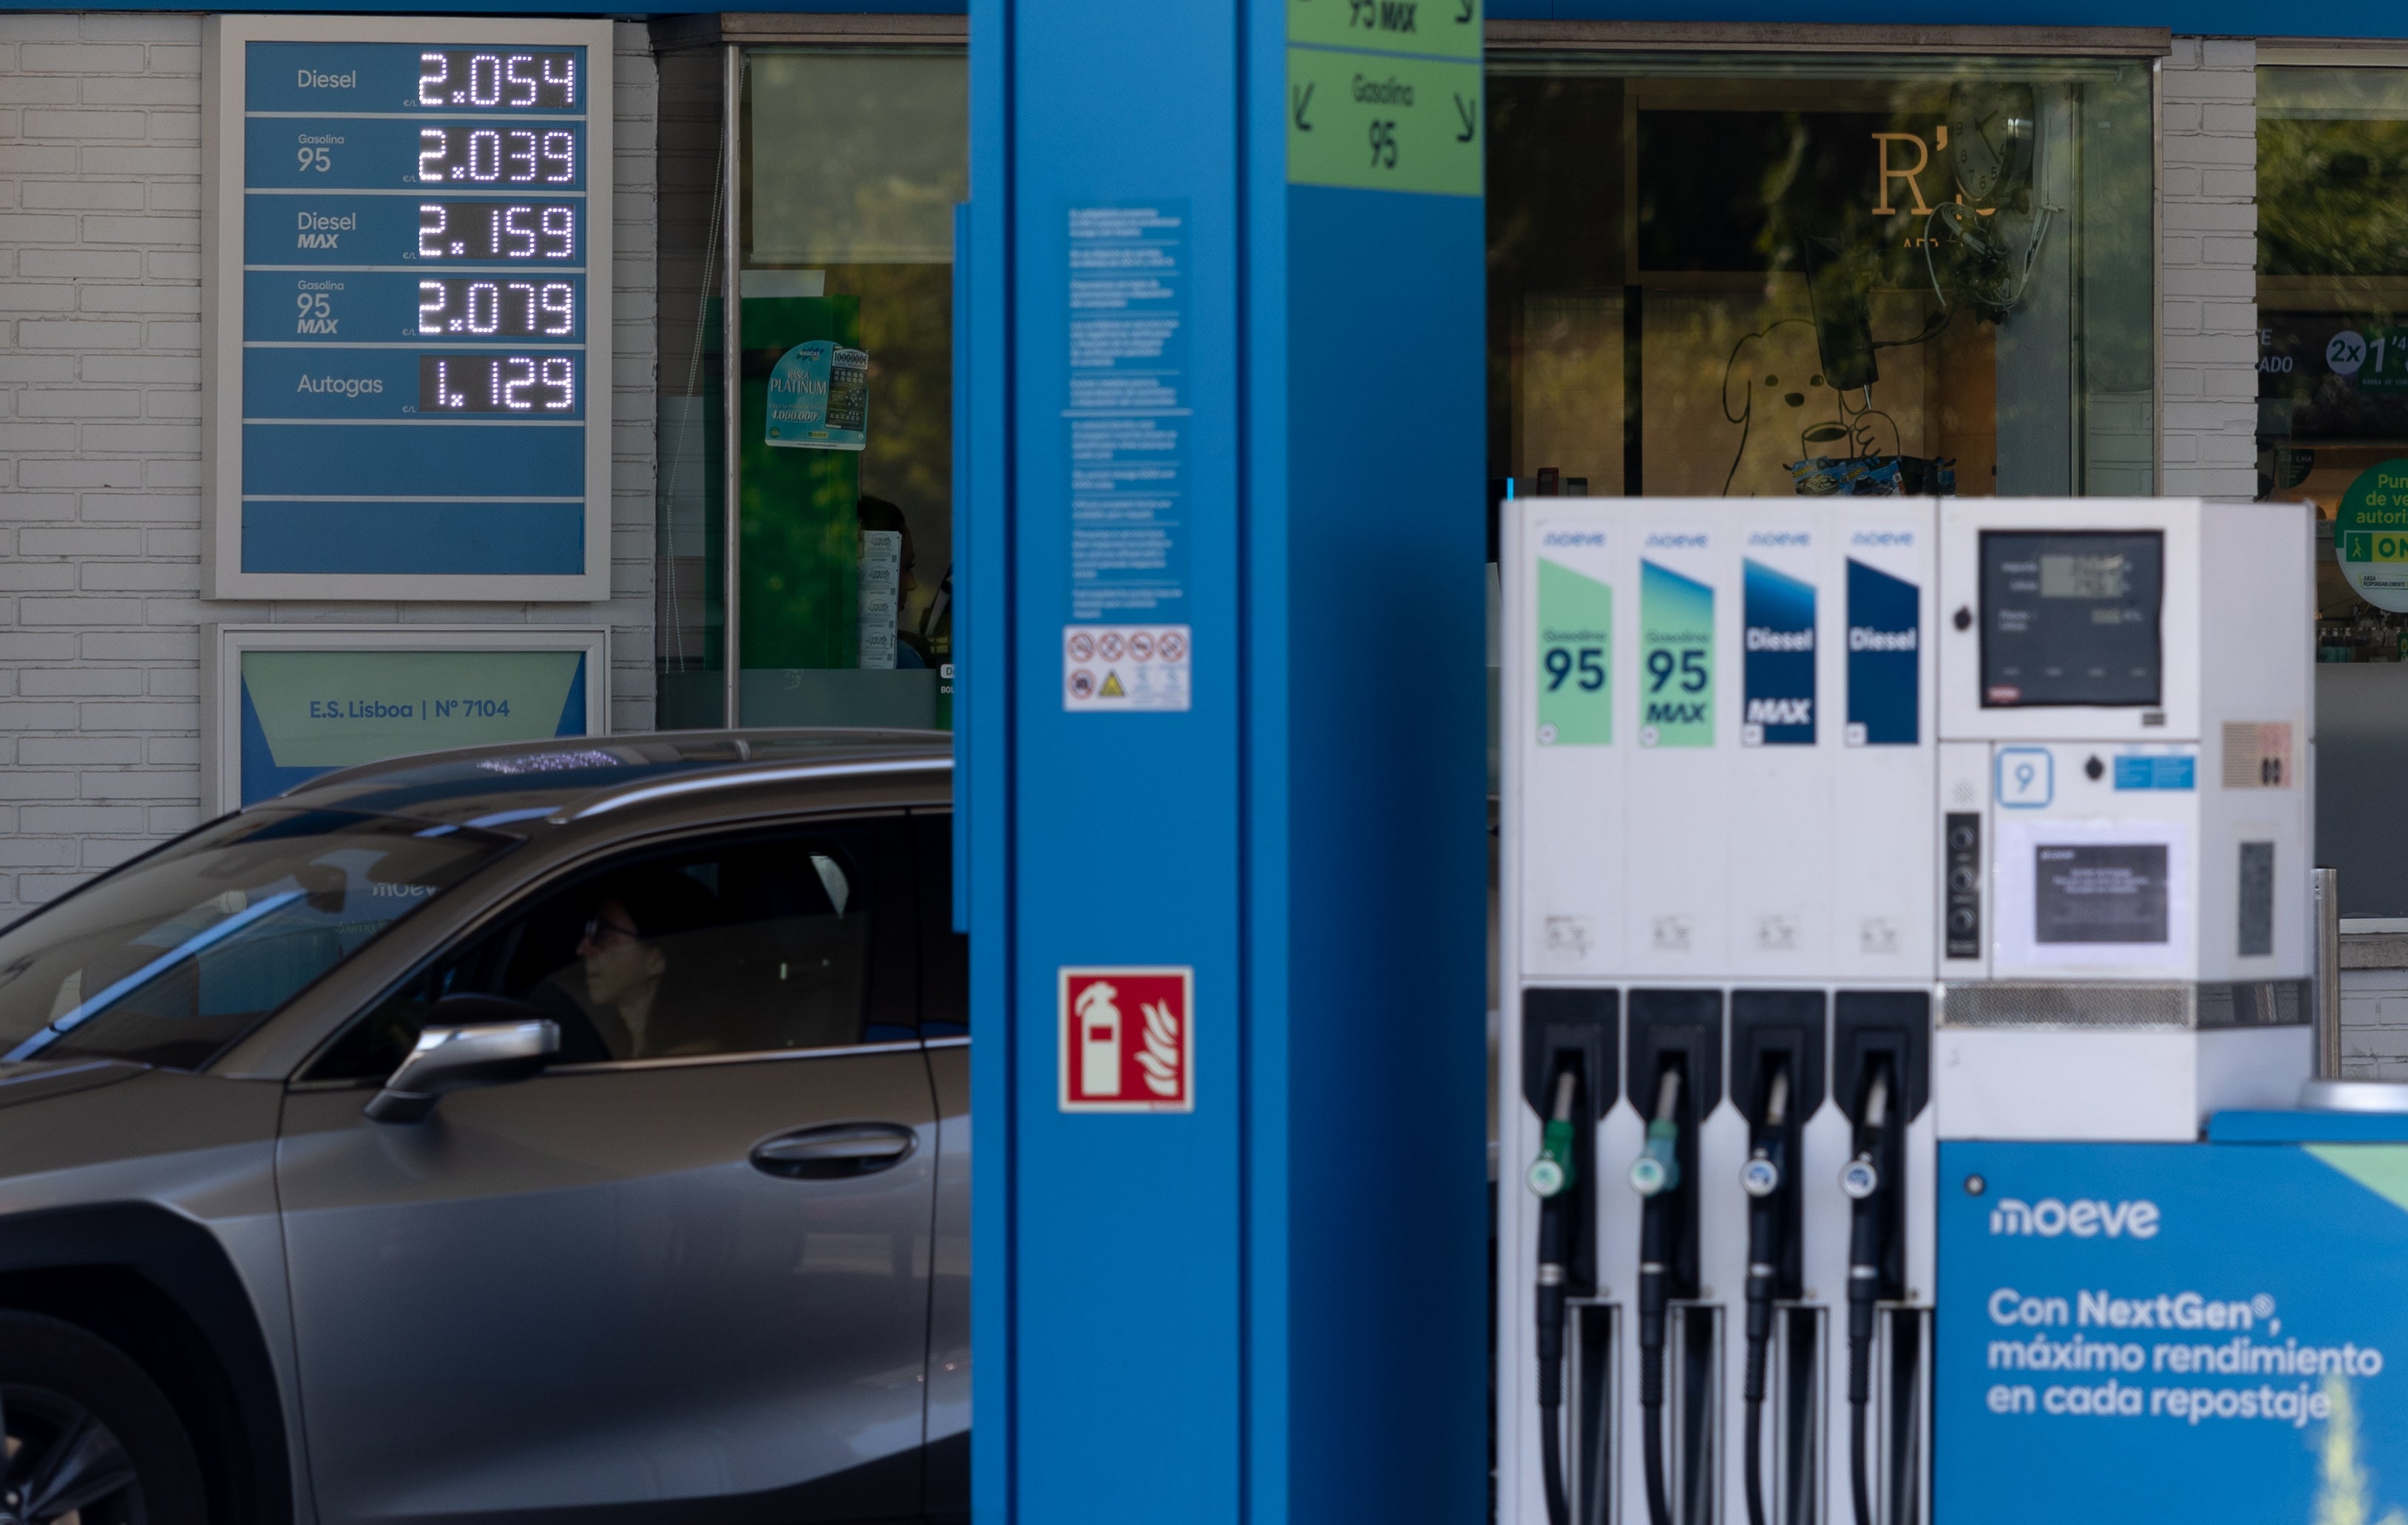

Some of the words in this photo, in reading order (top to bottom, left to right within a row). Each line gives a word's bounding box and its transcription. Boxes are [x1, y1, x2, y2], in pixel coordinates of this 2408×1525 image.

[298, 70, 356, 89] Diesel
[419, 54, 573, 105] 2.054
[1351, 73, 1414, 107] Gasolina
[298, 134, 345, 145] Gasolina
[1370, 120, 1398, 169] 95
[1999, 143, 2004, 157] 4
[297, 148, 330, 171] 95
[419, 130, 572, 181] 2.039
[1961, 149, 1967, 163] 8
[1970, 169, 1975, 183] 7
[1980, 176, 1986, 189] 6
[1991, 167, 1998, 180] 5
[298, 212, 356, 230] Diesel
[419, 205, 572, 257] 2.159
[297, 234, 339, 248] MAX
[298, 280, 344, 291] Gasolina
[297, 293, 330, 318] 95
[418, 282, 572, 333] 2.079
[297, 319, 339, 334] MAX
[2330, 339, 2361, 362] 2x
[297, 375, 383, 397] Autogas
[439, 358, 572, 407] 1.129
[770, 378, 827, 395] PLATINUM
[788, 371, 810, 379] RASCA
[2366, 490, 2387, 506] de
[2356, 509, 2408, 524] autori
[1746, 626, 1814, 651] Diesel
[1849, 626, 1917, 651] Diesel
[1544, 648, 1606, 693] 95
[1646, 648, 1709, 693] 95
[310, 700, 345, 719] E.S.
[349, 700, 413, 719] Lisboa
[463, 699, 510, 717] 7104
[1646, 702, 1706, 724] MAX
[1747, 697, 1811, 724] MAX
[2015, 762, 2035, 793] 9
[1989, 1198, 2160, 1238] moeve
[1987, 1288, 2069, 1327] Con
[1987, 1332, 2146, 1373] máximo
[2152, 1337, 2384, 1377] rendimiento
[1987, 1384, 2037, 1415] en
[2043, 1378, 2143, 1416] cada
[2151, 1382, 2332, 1429] repostaje
